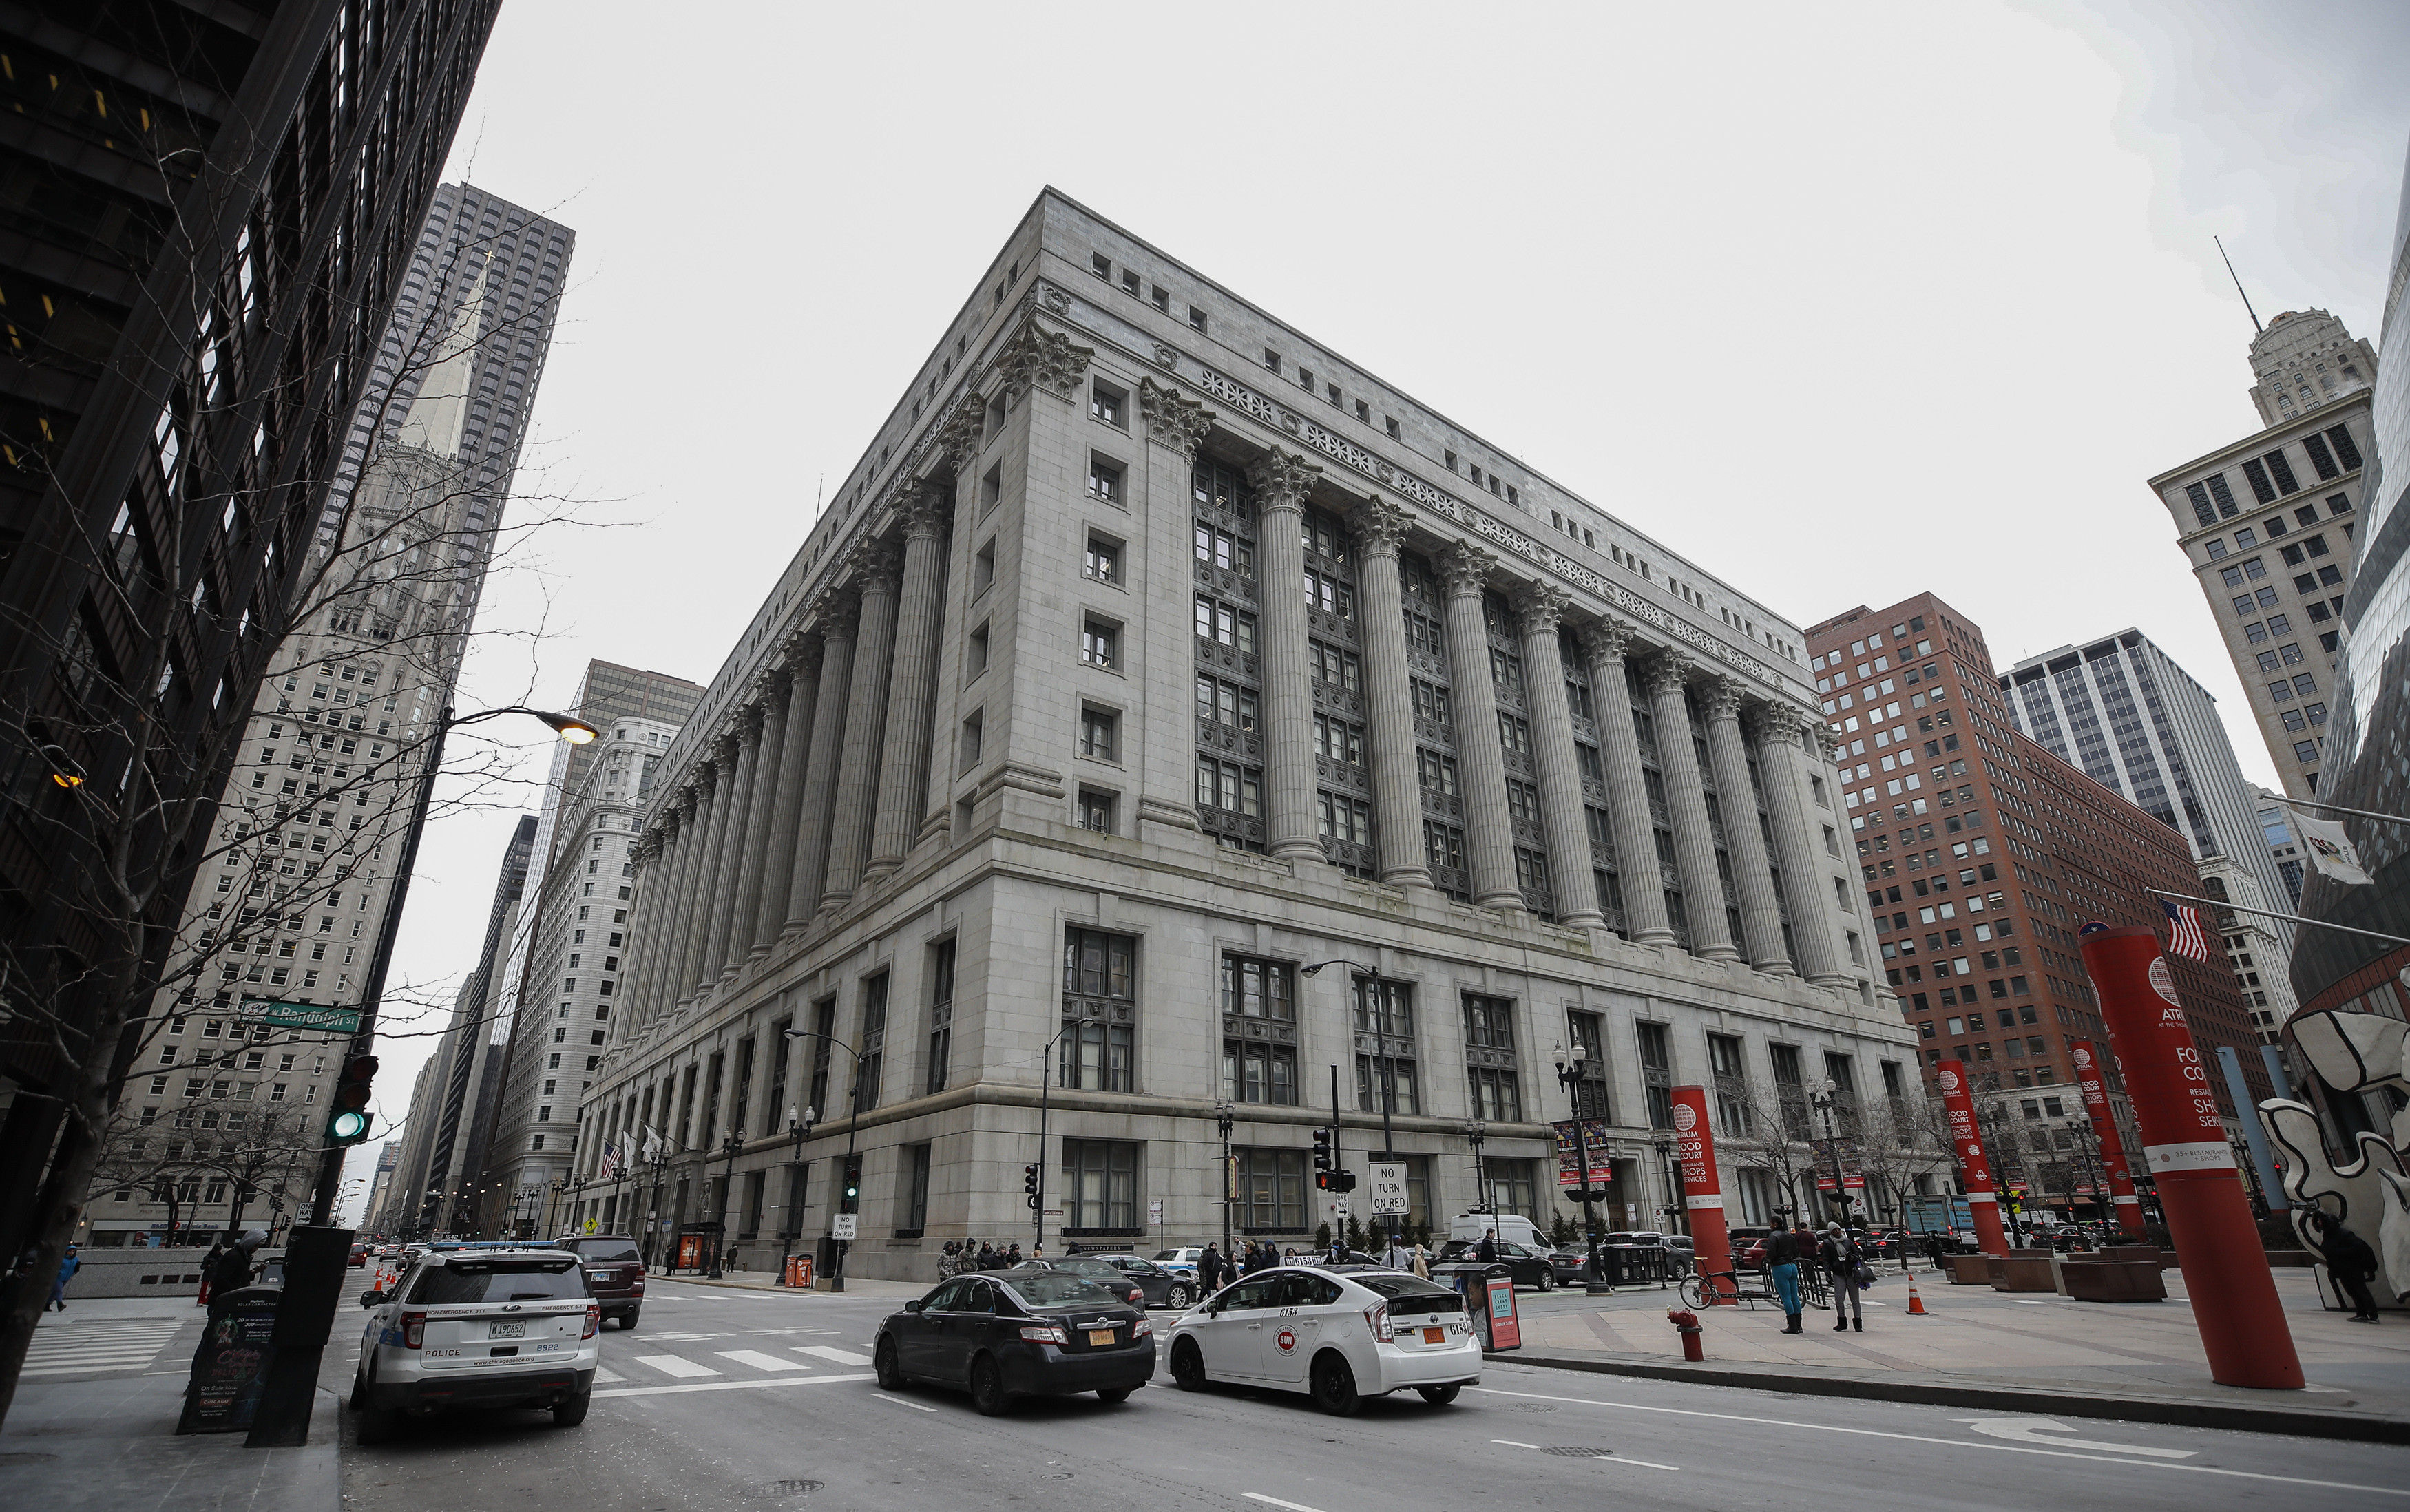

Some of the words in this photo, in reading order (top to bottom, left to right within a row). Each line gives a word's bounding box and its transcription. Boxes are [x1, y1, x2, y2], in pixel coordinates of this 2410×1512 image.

[280, 1008, 342, 1027] Randolph
[346, 1016, 355, 1025] St
[1680, 1151, 1703, 1160] COURT
[1381, 1168, 1394, 1178] NO
[1378, 1183, 1400, 1193] TURN
[1374, 1198, 1386, 1208] ON
[1390, 1197, 1405, 1208] RED
[1295, 1257, 1312, 1266] 6153
[1279, 1308, 1298, 1318] 6153
[499, 1324, 524, 1334] 190652
[1449, 1323, 1467, 1335] 6153
[1280, 1336, 1292, 1345] SUN
[425, 1349, 461, 1357] POLICE
[474, 1357, 534, 1365] www.chicagopolice.org
